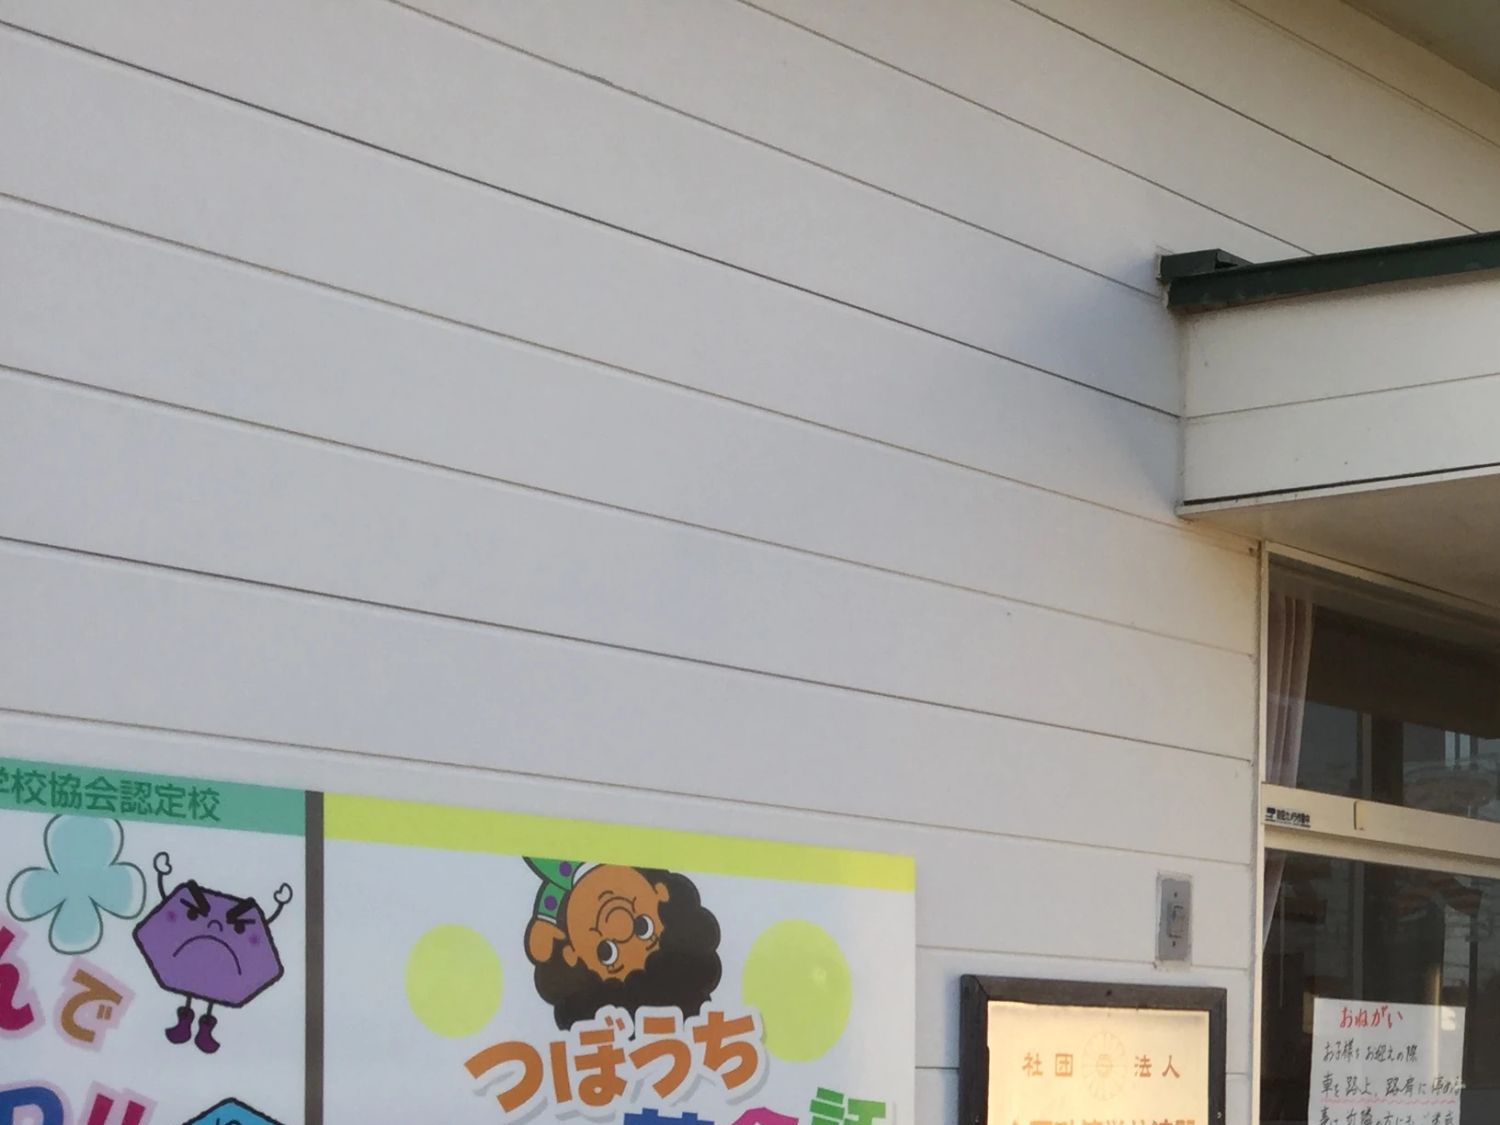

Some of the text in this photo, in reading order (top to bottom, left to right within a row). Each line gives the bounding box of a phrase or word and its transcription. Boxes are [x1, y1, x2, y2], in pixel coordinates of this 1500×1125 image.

[1339, 1005, 1404, 1029] おねがい
[463, 1010, 757, 1113] つぼうち
